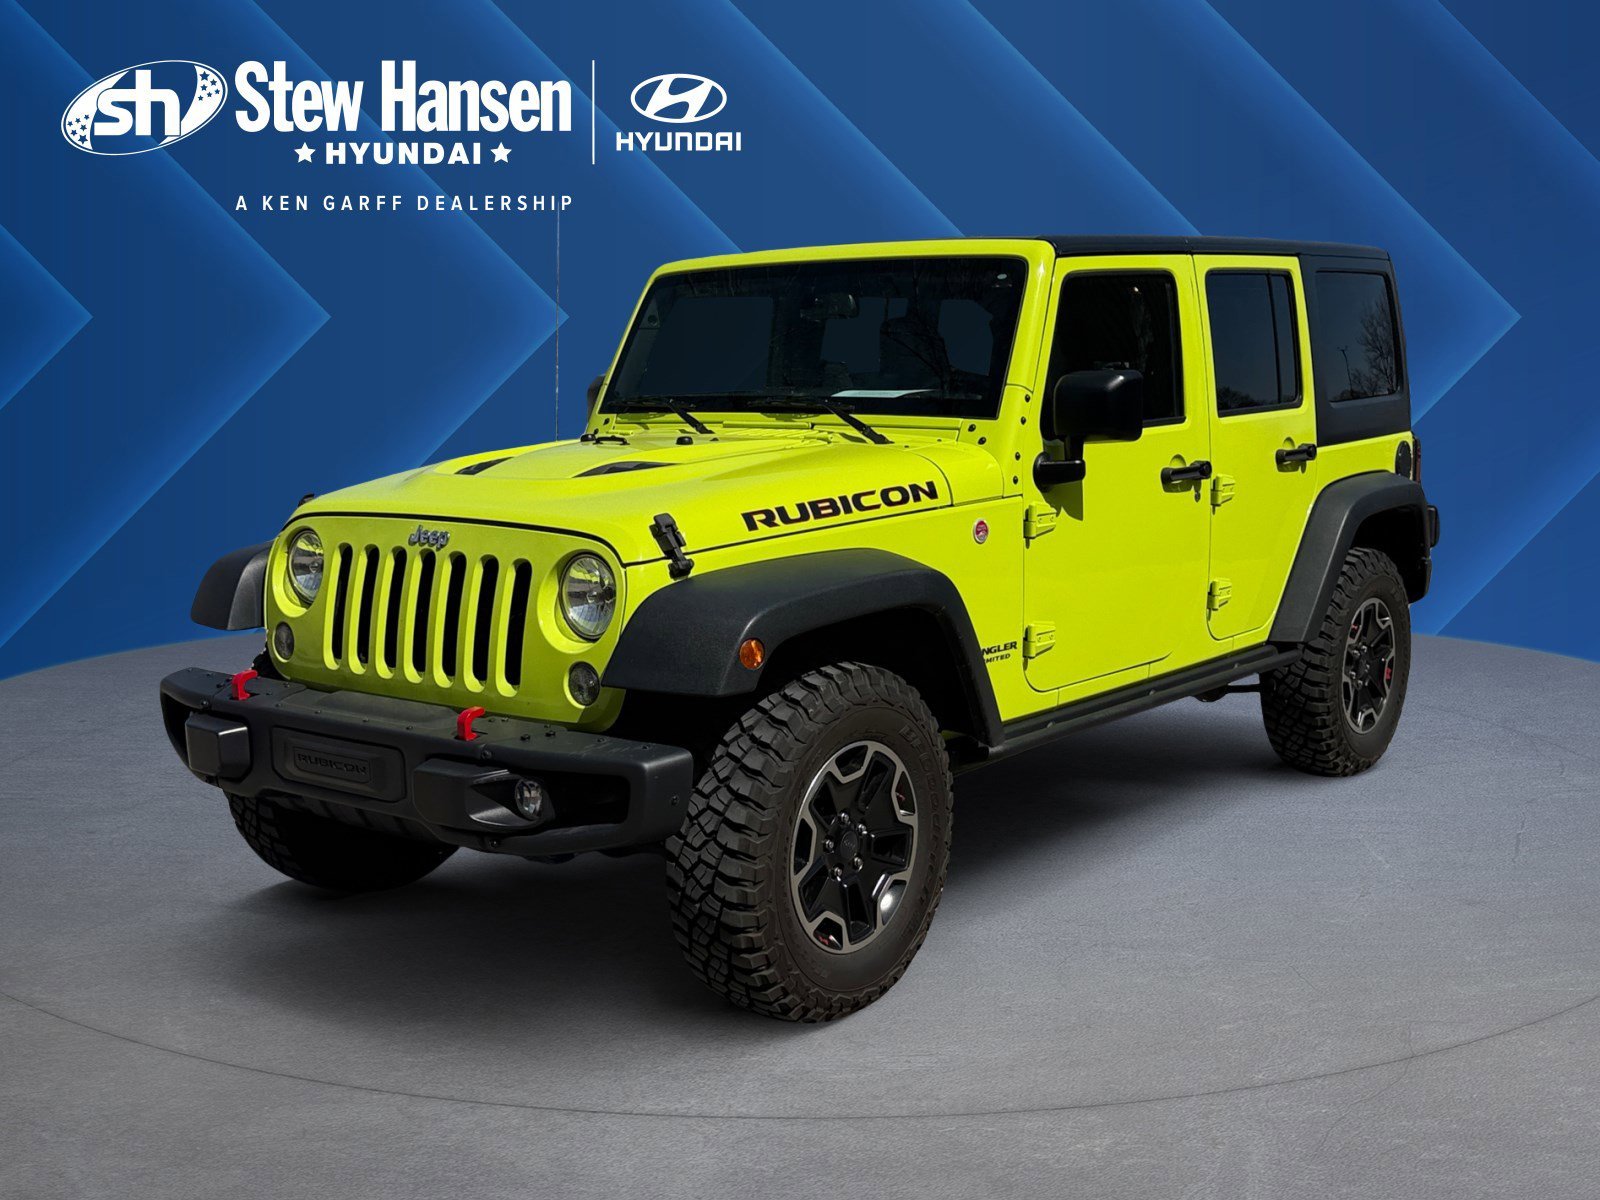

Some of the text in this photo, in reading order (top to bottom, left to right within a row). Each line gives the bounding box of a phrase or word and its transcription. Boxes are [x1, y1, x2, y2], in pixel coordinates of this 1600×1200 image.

[741, 480, 939, 532] RUBICON
[408, 524, 450, 551] Jeep
[982, 641, 1018, 655] NGLER
[985, 653, 1011, 664] MITED
[297, 752, 368, 776] RUBICON
